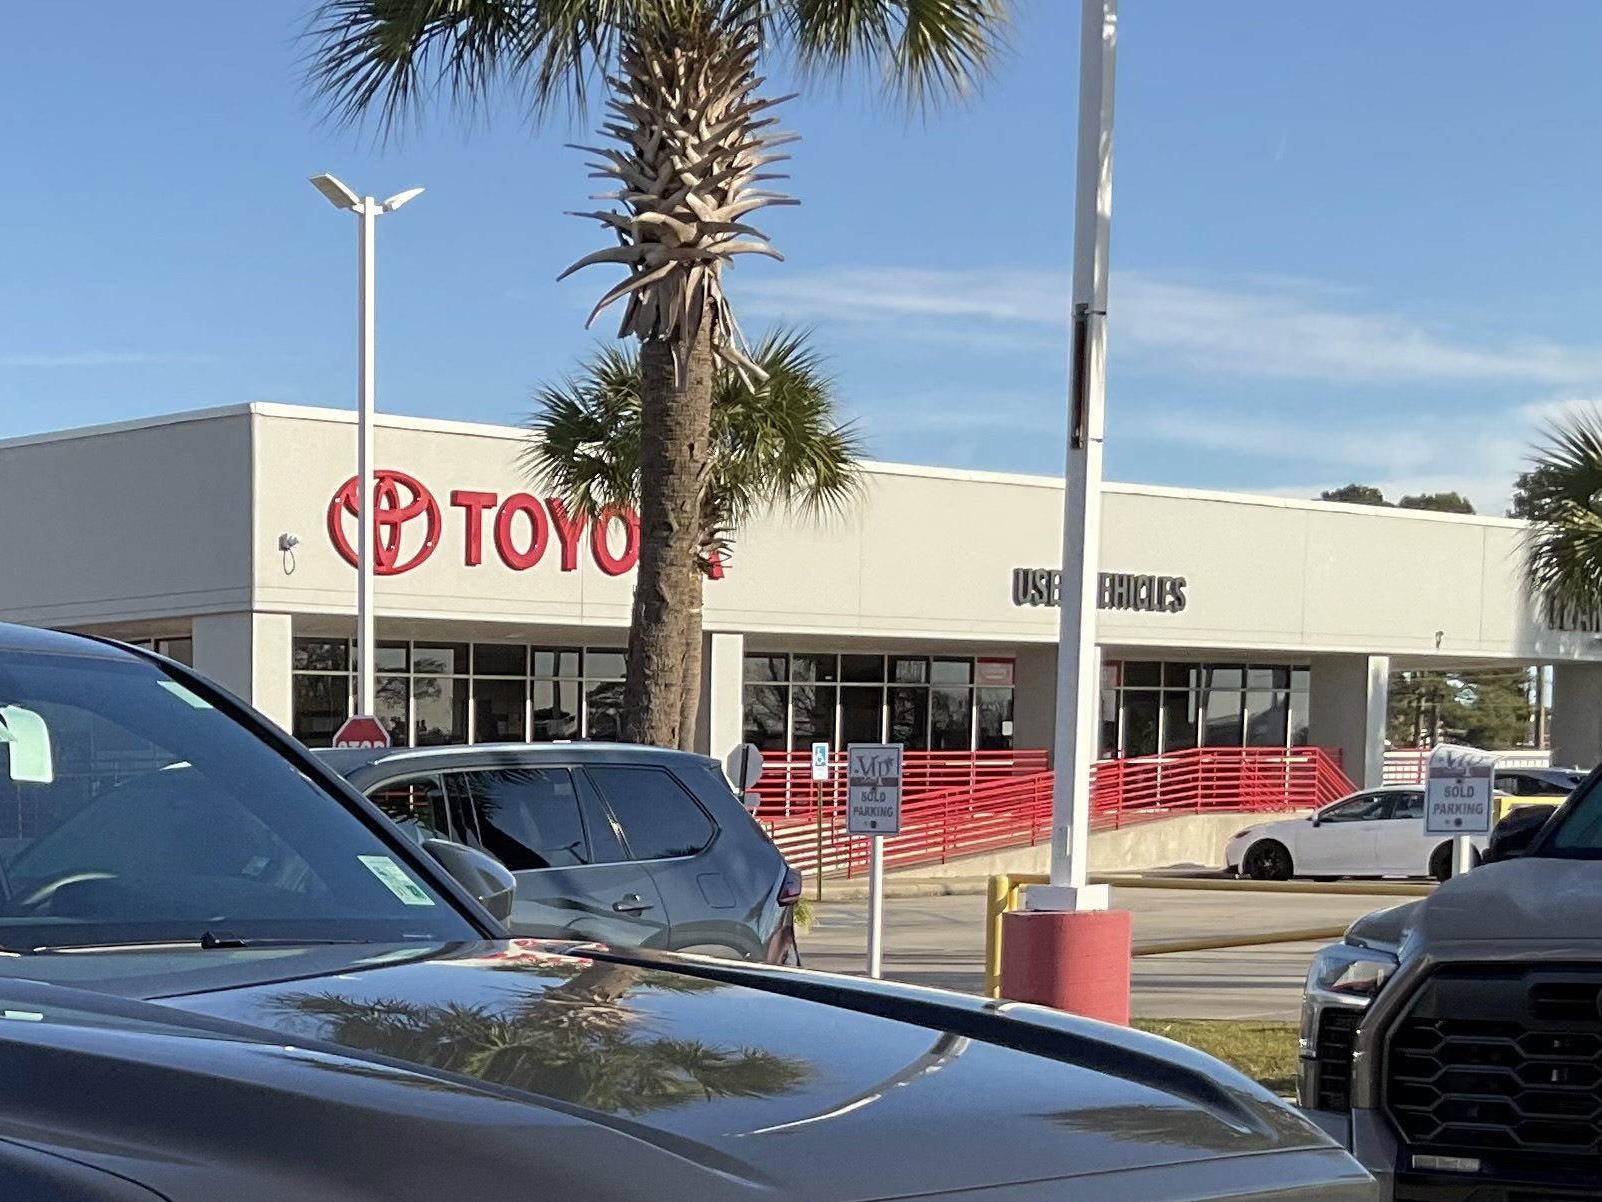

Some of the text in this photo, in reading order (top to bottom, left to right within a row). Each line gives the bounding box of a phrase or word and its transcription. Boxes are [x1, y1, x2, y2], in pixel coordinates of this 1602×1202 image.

[450, 490, 725, 580] TOYO
[1013, 568, 1186, 613] USE EHICLES
[861, 791, 886, 802] SOLD
[1444, 785, 1475, 798] SOLD
[853, 806, 893, 817] PARKING
[1433, 802, 1484, 815] PARKING
